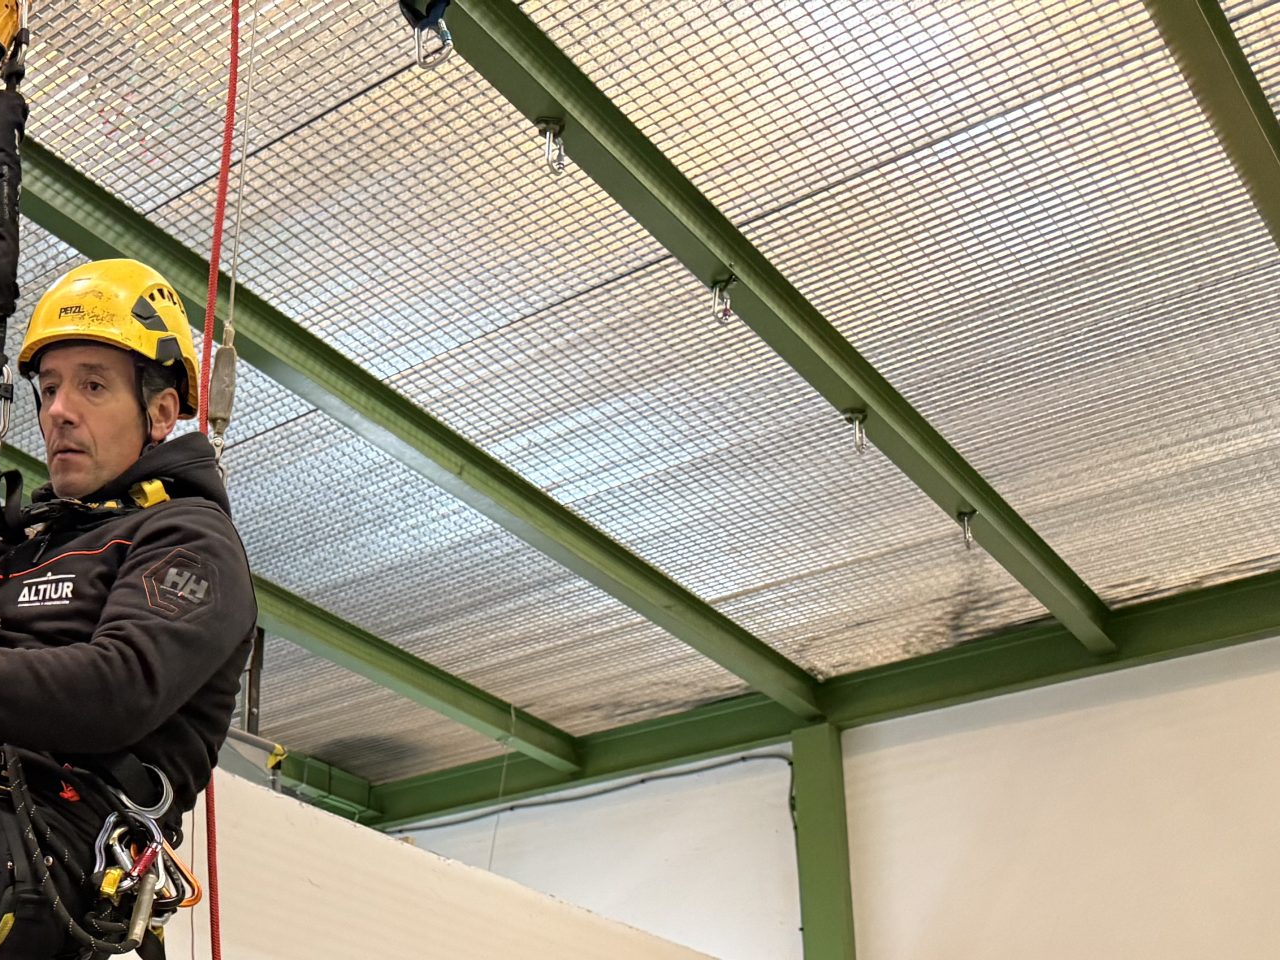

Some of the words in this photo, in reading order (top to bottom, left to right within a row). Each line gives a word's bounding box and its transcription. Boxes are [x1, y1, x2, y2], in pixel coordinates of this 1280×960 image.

[59, 305, 85, 319] PETZL
[18, 582, 74, 602] ALTIUR
[163, 567, 209, 600] HH
